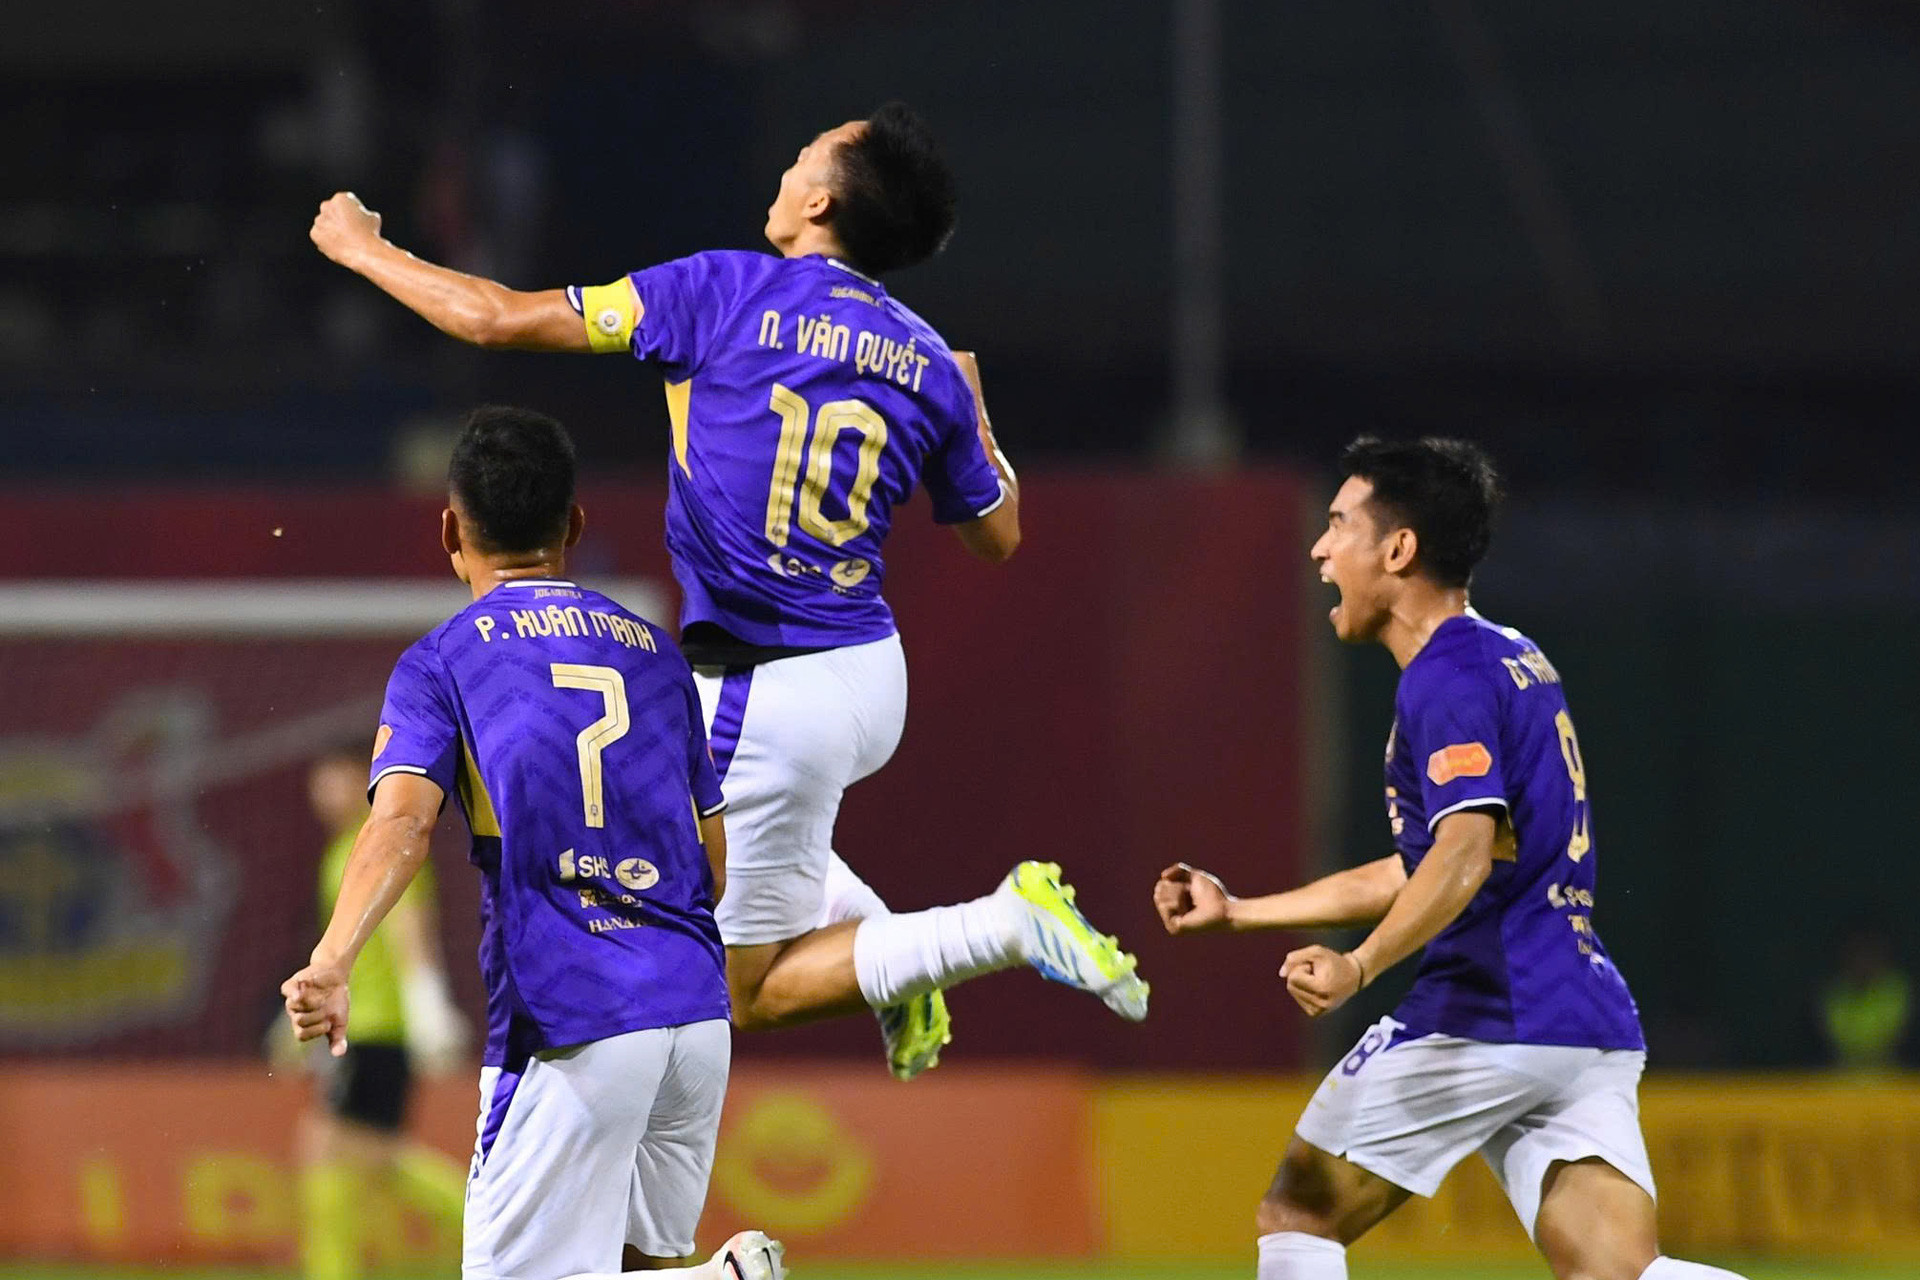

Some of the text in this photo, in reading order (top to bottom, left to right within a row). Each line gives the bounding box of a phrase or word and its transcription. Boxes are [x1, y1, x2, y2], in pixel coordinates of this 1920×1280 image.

[758, 310, 784, 350] N.
[797, 313, 850, 363] VĂN
[765, 382, 888, 547] 10
[474, 604, 658, 654] P. XUÂN MẠNH
[550, 662, 631, 829] 7
[1342, 1032, 1384, 1076] 8
